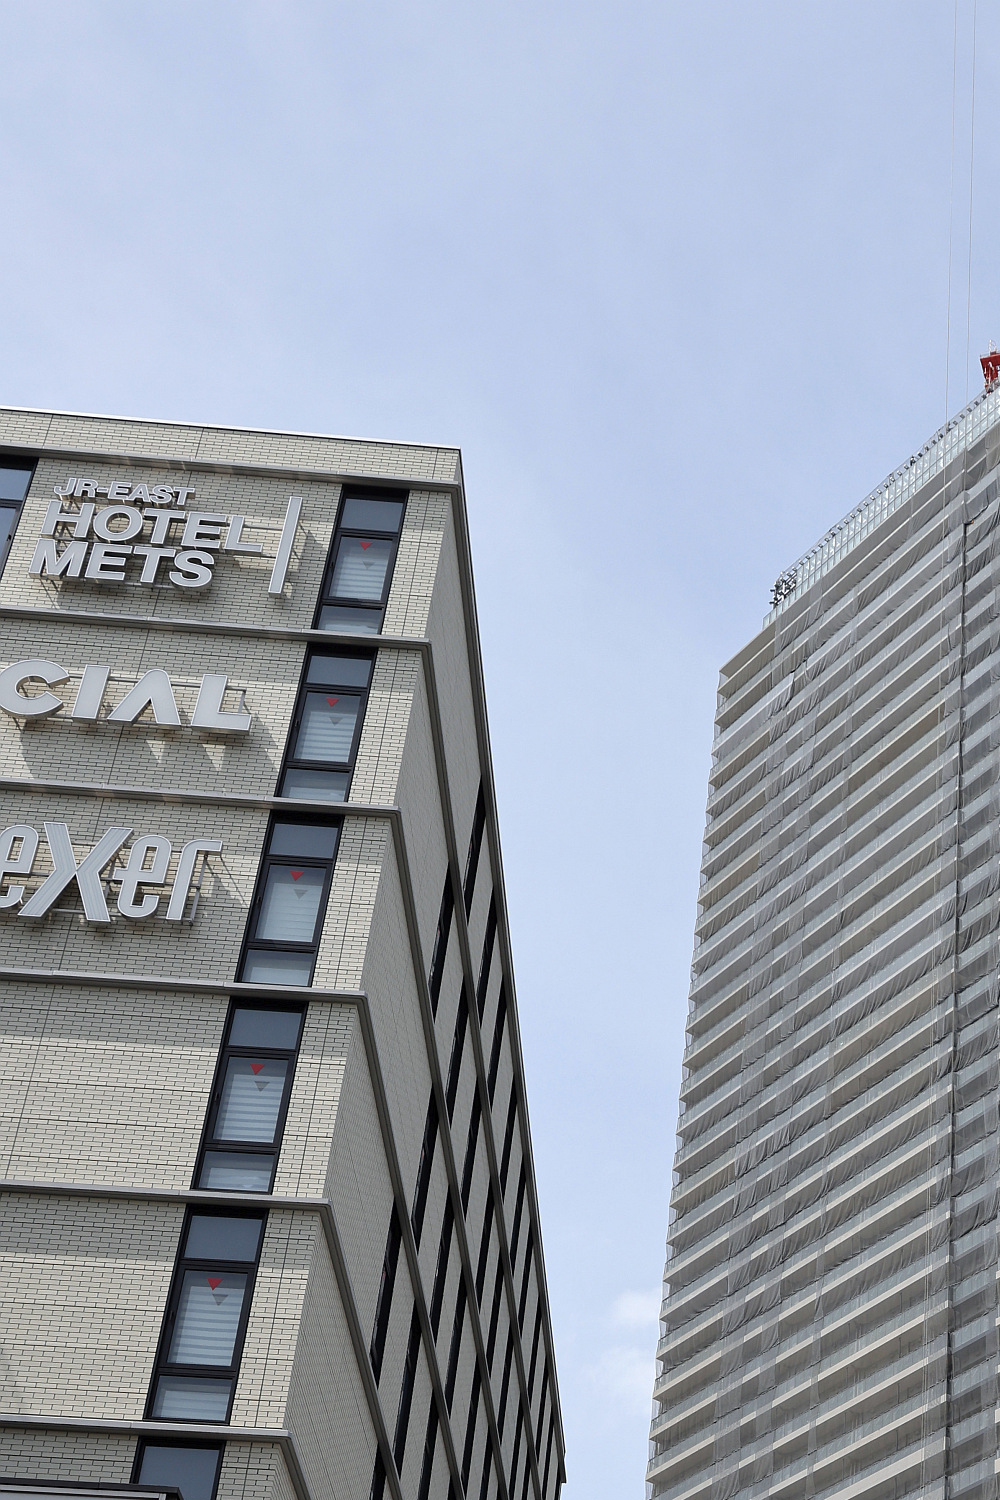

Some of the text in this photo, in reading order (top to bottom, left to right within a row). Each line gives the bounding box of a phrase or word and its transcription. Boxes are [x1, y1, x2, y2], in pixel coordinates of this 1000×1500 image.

[53, 477, 195, 506] JR-EAST
[41, 500, 264, 553] HOTEL
[28, 538, 215, 588] METS
[0, 659, 252, 732] CIAL
